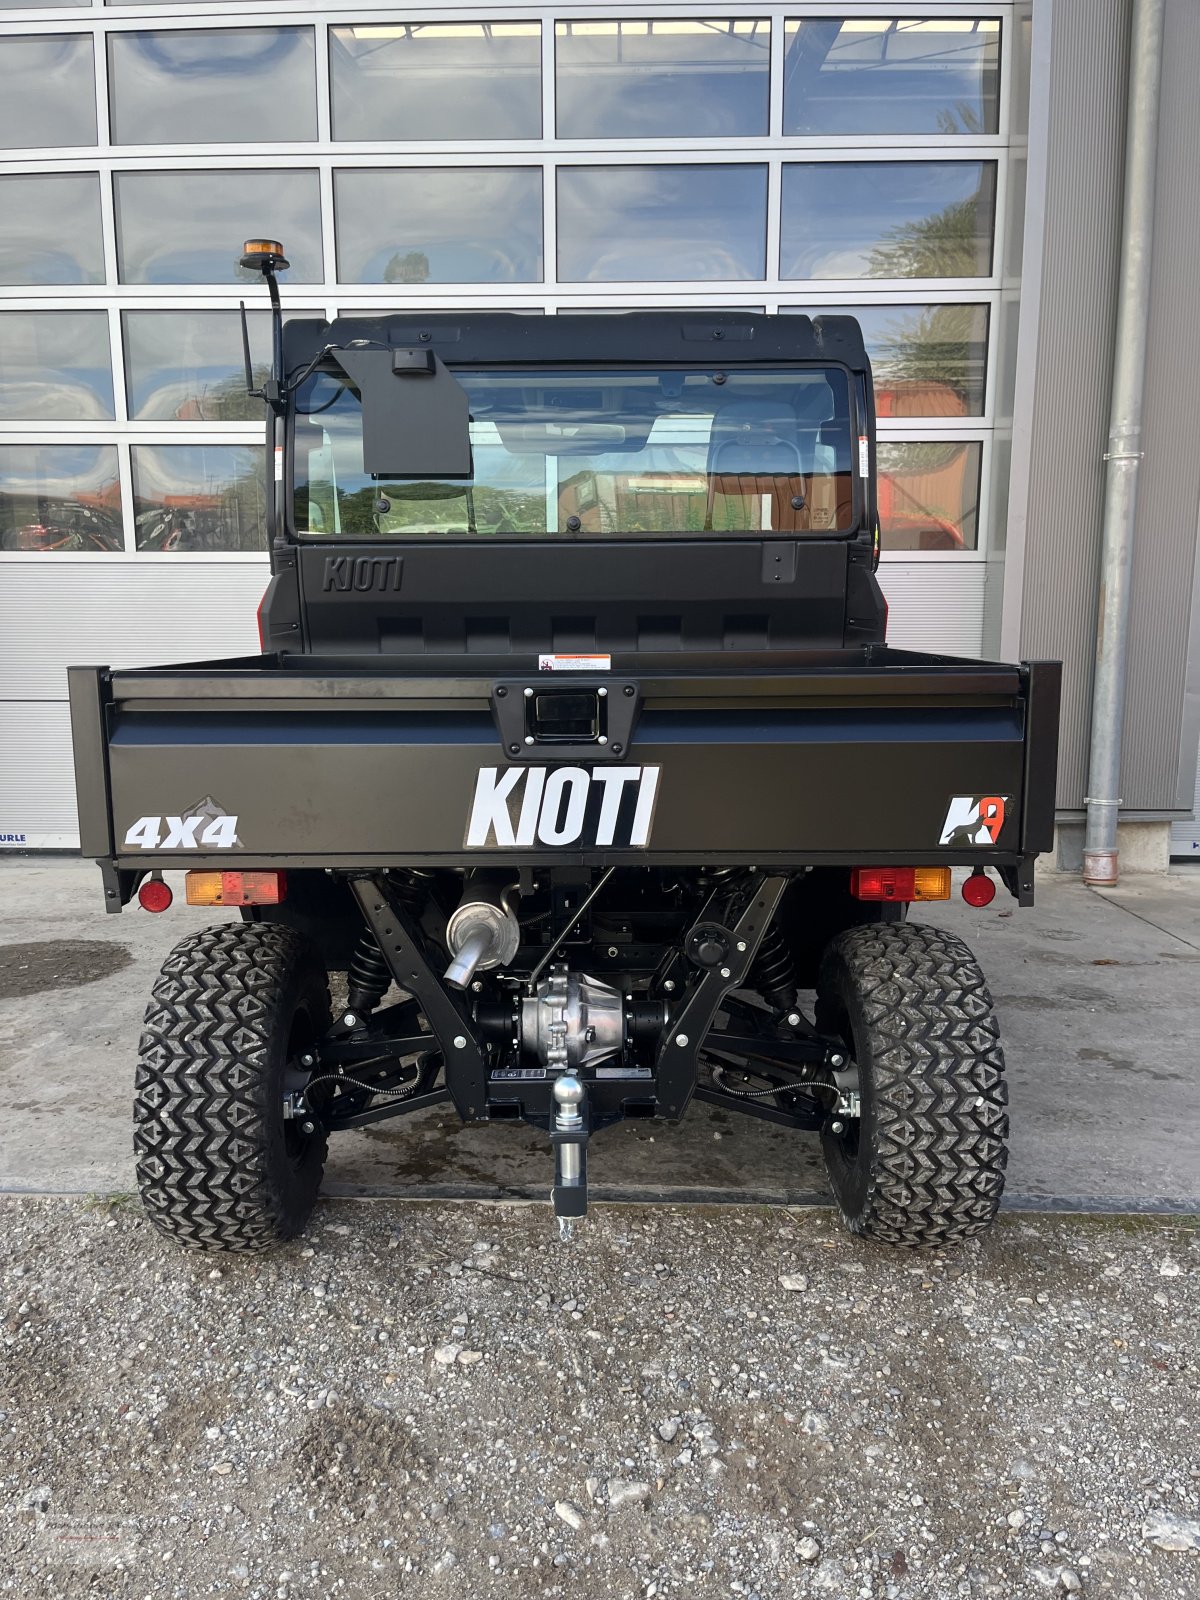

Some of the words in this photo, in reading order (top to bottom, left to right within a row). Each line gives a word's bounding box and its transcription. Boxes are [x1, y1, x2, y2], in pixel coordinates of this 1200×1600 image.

[323, 557, 403, 592] KIOTI
[466, 766, 660, 846] KIOTI
[938, 796, 1008, 845] K9
